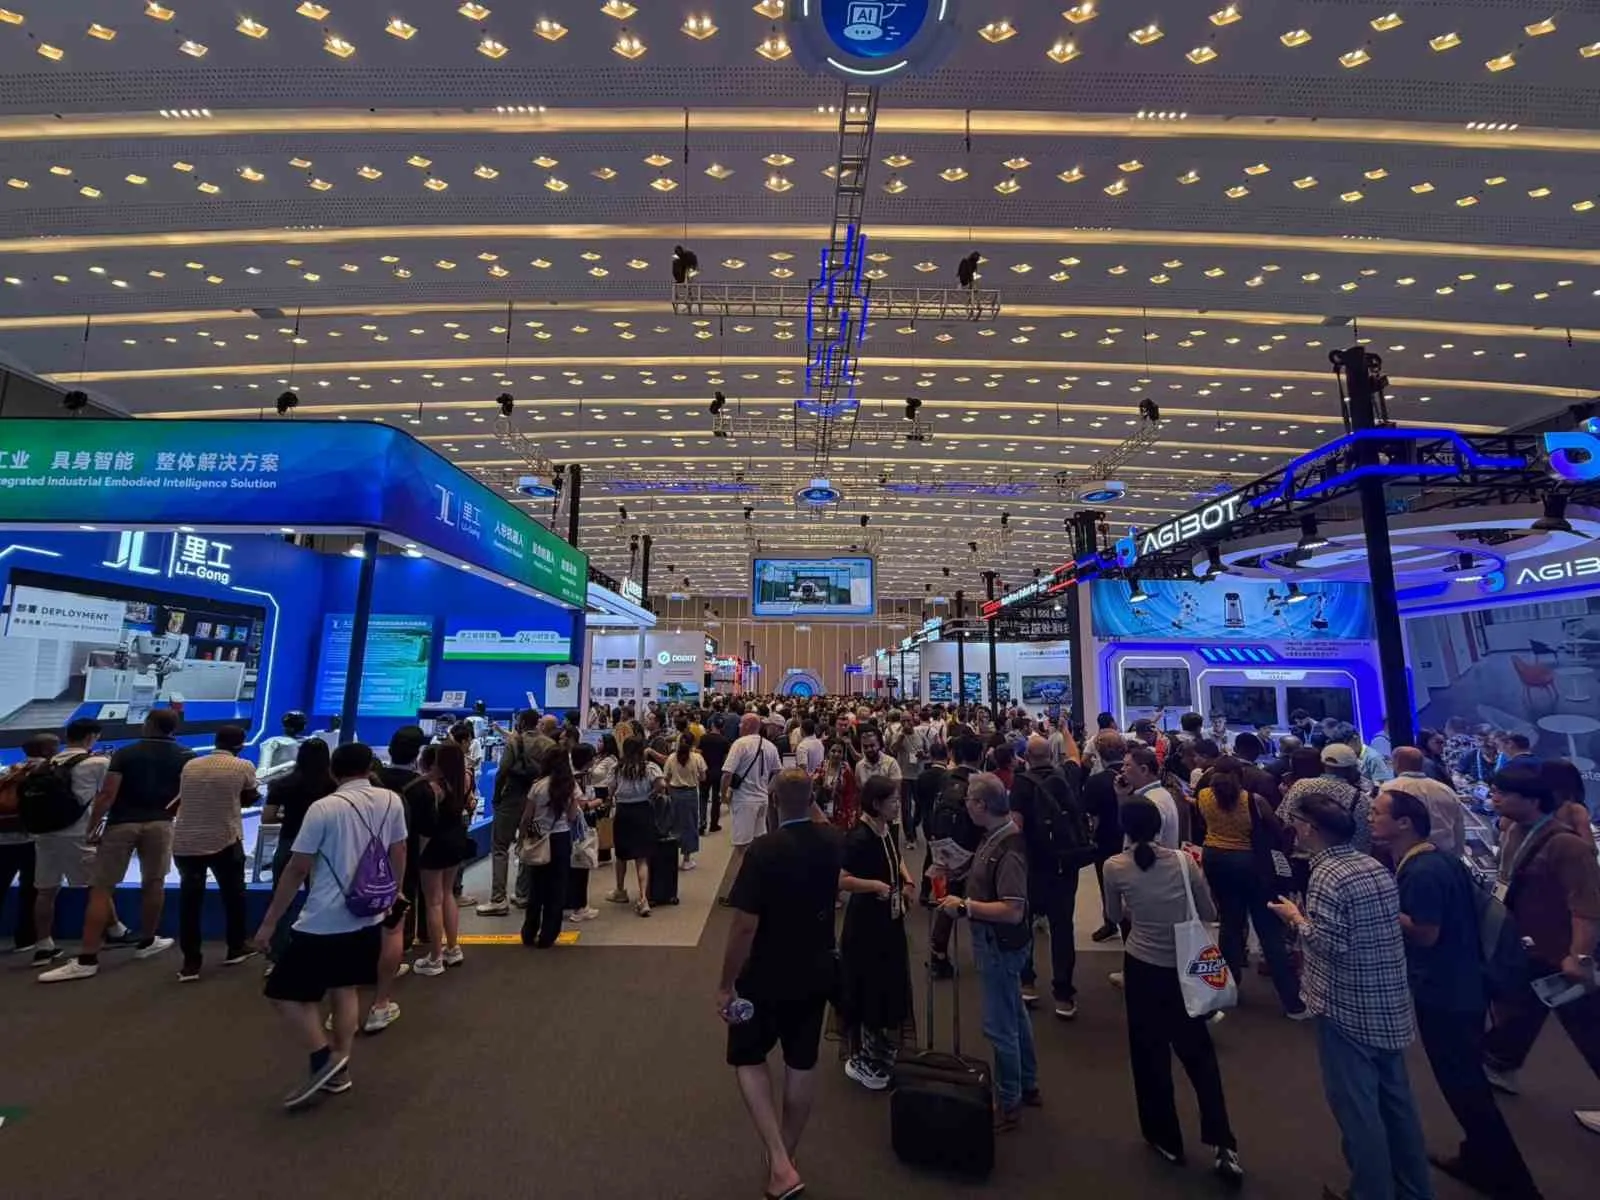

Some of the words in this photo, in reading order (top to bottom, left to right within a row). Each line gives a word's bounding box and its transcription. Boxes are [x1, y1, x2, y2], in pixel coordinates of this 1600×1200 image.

[857, 9, 873, 21] AI
[50, 450, 135, 471] 具身智能
[155, 451, 280, 473] 整体解决方案
[0, 476, 45, 489] egrated
[47, 476, 102, 487] Industrial
[104, 476, 160, 488] Embodied
[163, 477, 228, 490] Intelligence
[230, 477, 277, 489] Solution
[1142, 495, 1240, 555] AGIBOT
[181, 535, 232, 568] 里工
[41, 606, 109, 621] DEPLOYMENT
